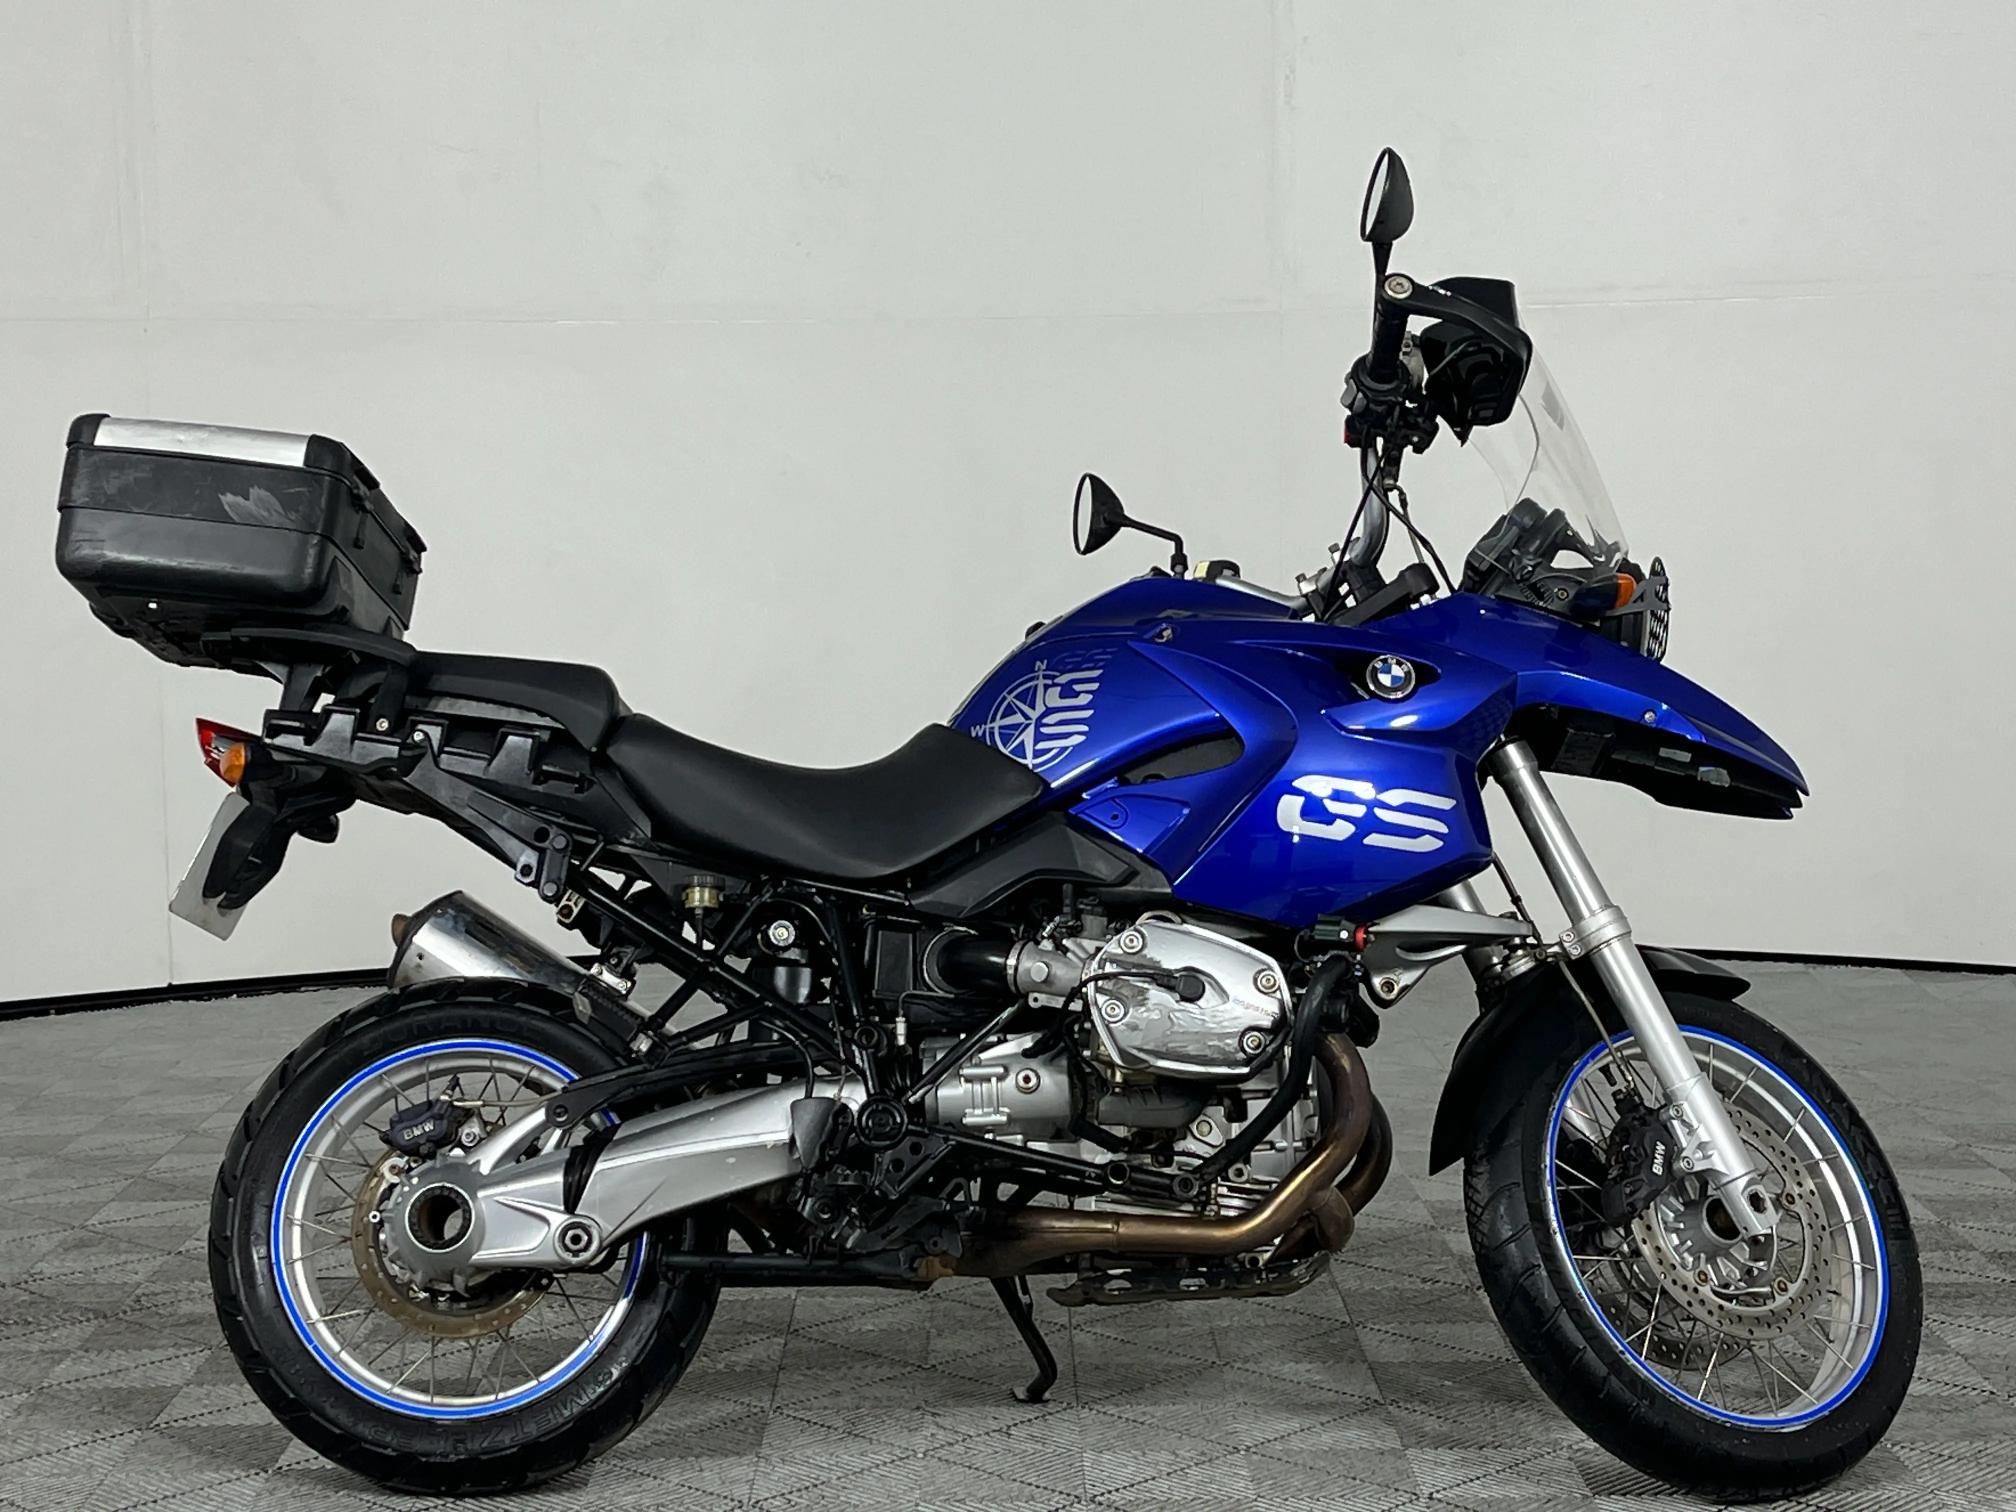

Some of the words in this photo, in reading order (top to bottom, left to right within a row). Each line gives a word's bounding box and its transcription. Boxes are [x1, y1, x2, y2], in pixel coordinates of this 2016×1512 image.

[1035, 659, 1047, 672] N
[1277, 774, 1457, 852] GS
[403, 1119, 434, 1140] BMW
[1652, 1140, 1666, 1175] BMW
